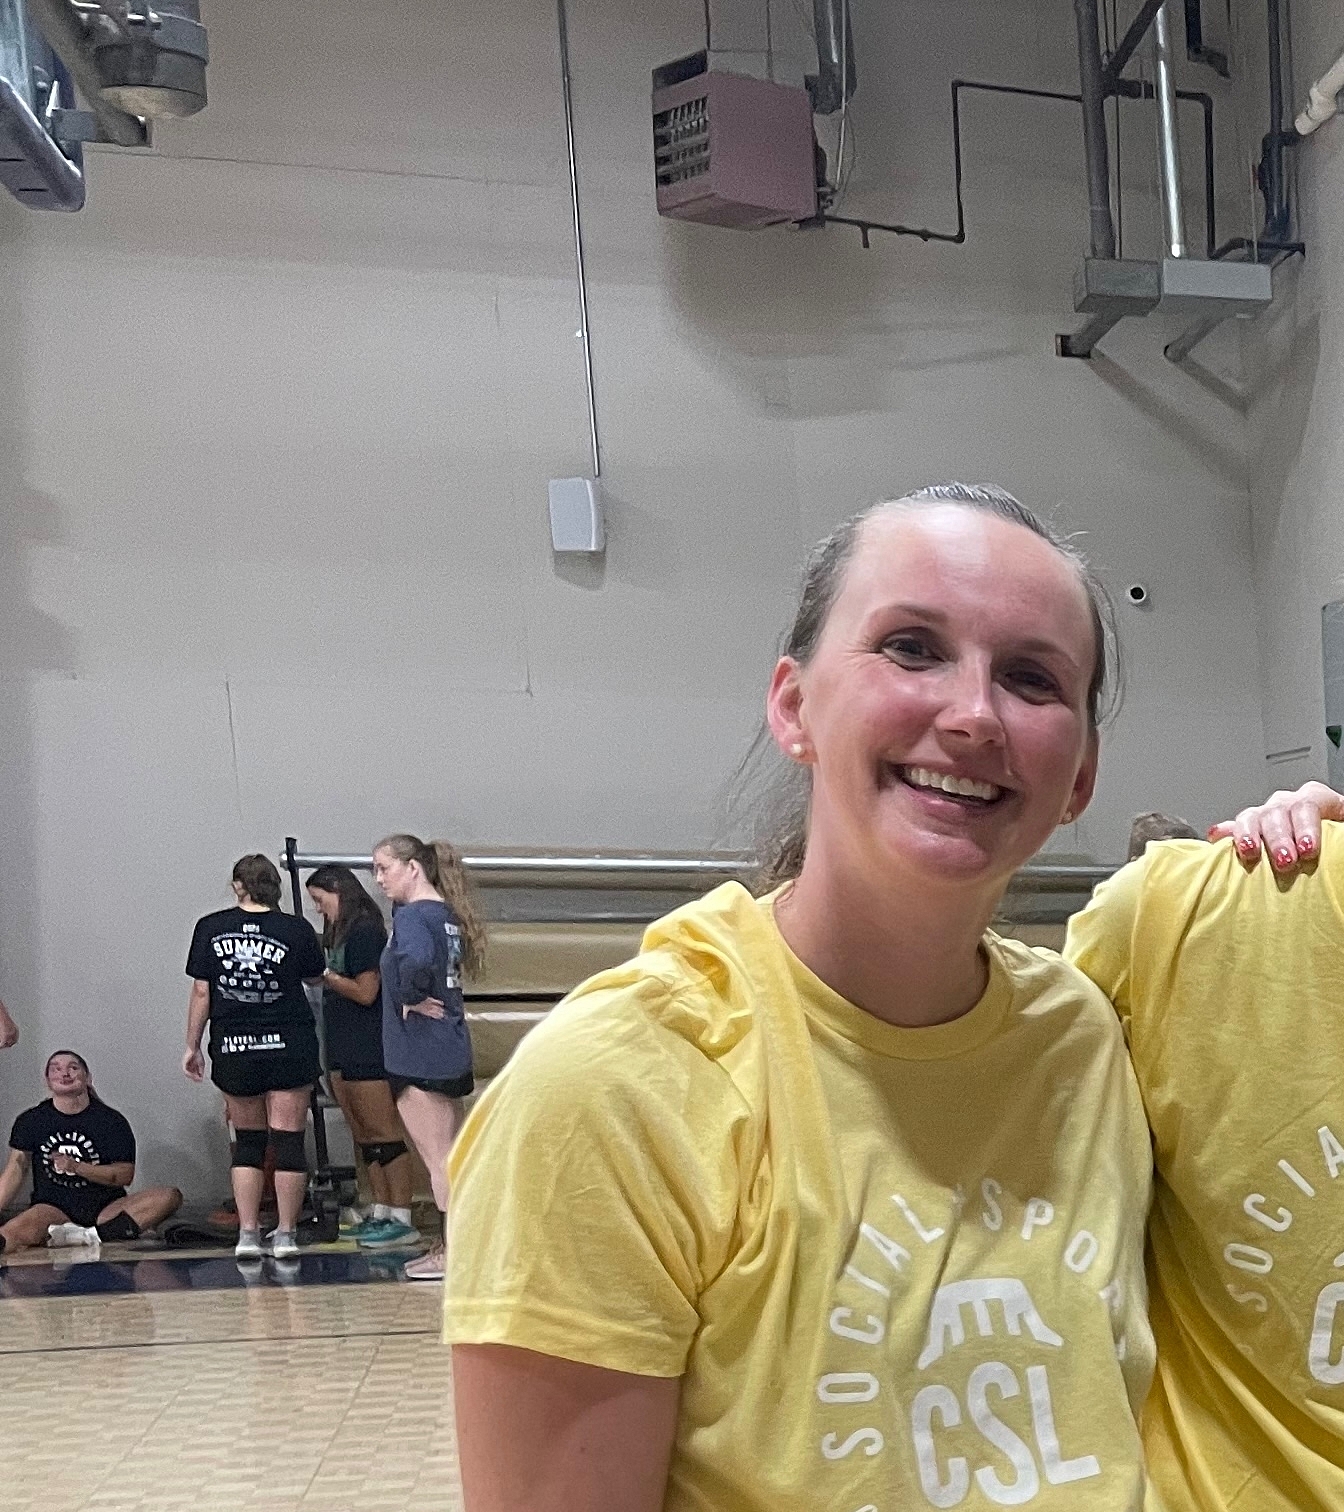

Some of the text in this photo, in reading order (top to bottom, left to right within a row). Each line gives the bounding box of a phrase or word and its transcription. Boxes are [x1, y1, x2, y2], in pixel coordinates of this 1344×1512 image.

[213, 938, 286, 965] SUMMER
[817, 1194, 945, 1460] SOCIAL
[911, 1361, 1102, 1509] CSL
